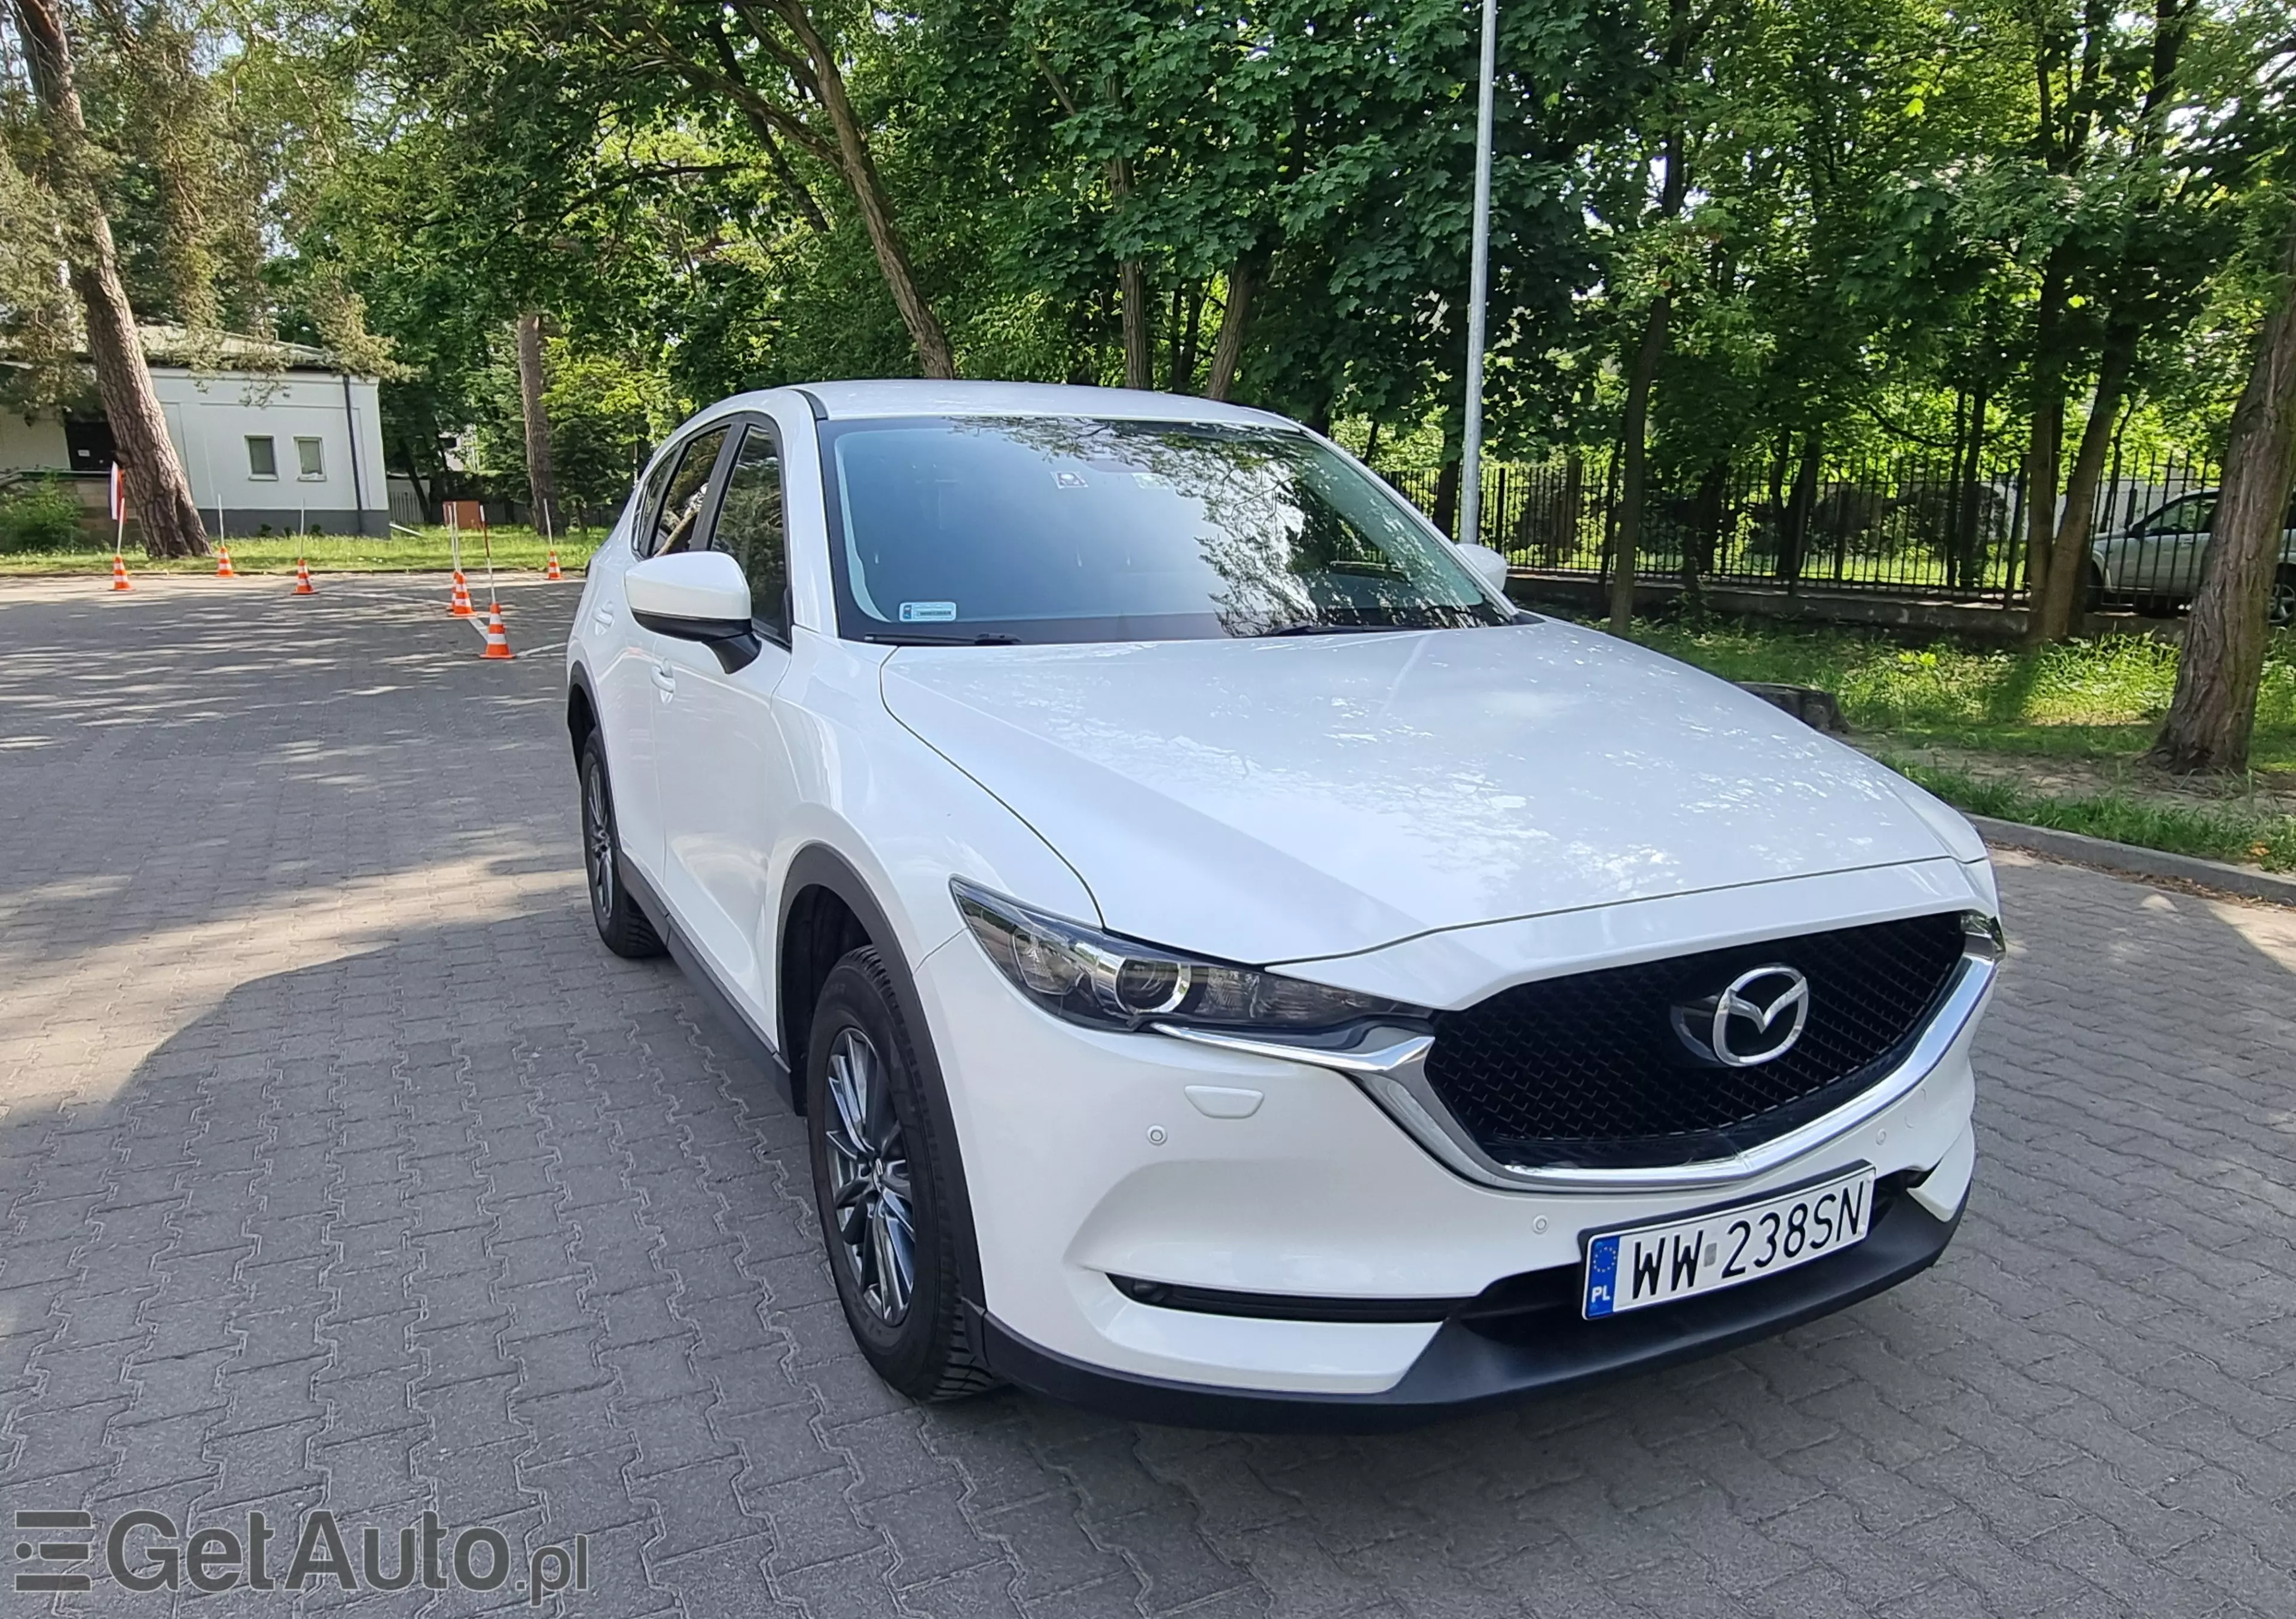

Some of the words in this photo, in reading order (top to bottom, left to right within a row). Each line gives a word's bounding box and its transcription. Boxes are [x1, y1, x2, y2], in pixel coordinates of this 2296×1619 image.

[1632, 1230, 1703, 1299] WW
[1721, 1181, 1864, 1278] 238SN
[1591, 1285, 1610, 1303] PL
